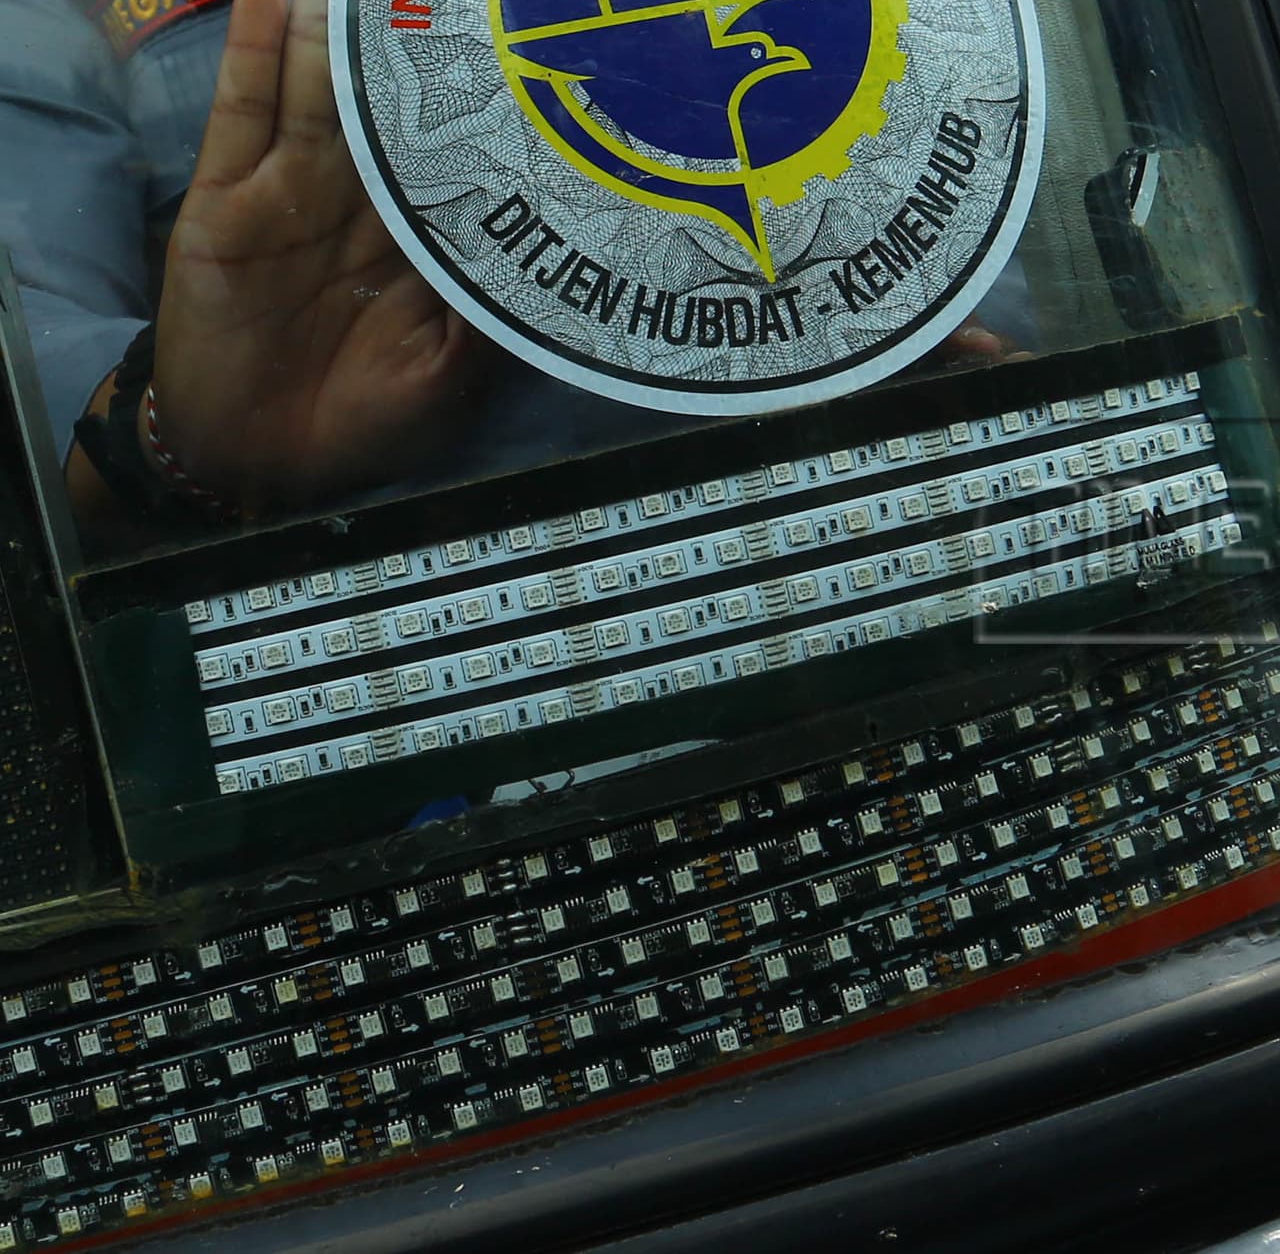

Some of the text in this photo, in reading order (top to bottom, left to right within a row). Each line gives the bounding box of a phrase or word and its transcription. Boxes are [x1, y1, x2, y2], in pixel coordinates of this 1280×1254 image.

[480, 193, 625, 324] DITJEN
[628, 286, 805, 348] HUBDAT
[832, 110, 982, 313] KEMENHUB
